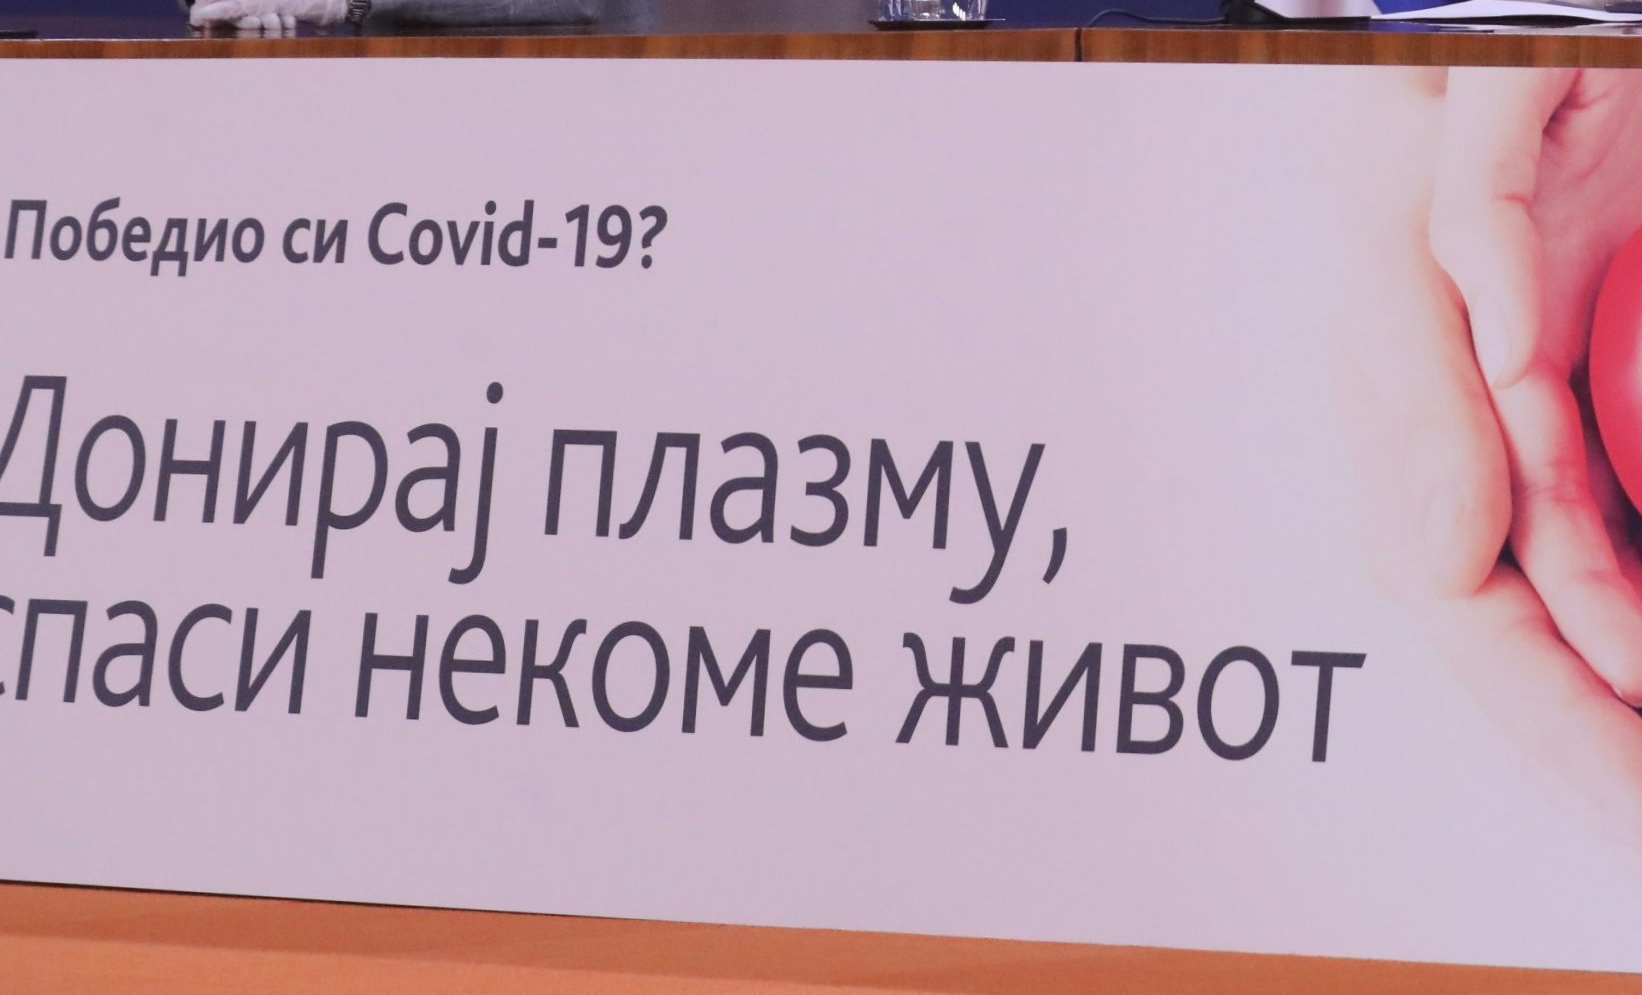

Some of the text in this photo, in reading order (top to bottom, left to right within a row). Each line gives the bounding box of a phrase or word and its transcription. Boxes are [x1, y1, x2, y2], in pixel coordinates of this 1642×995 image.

[4, 196, 668, 278] Победио си Covid-19?
[0, 375, 1068, 605] Донирај плазму,
[0, 594, 1367, 763] паси некоме живот
